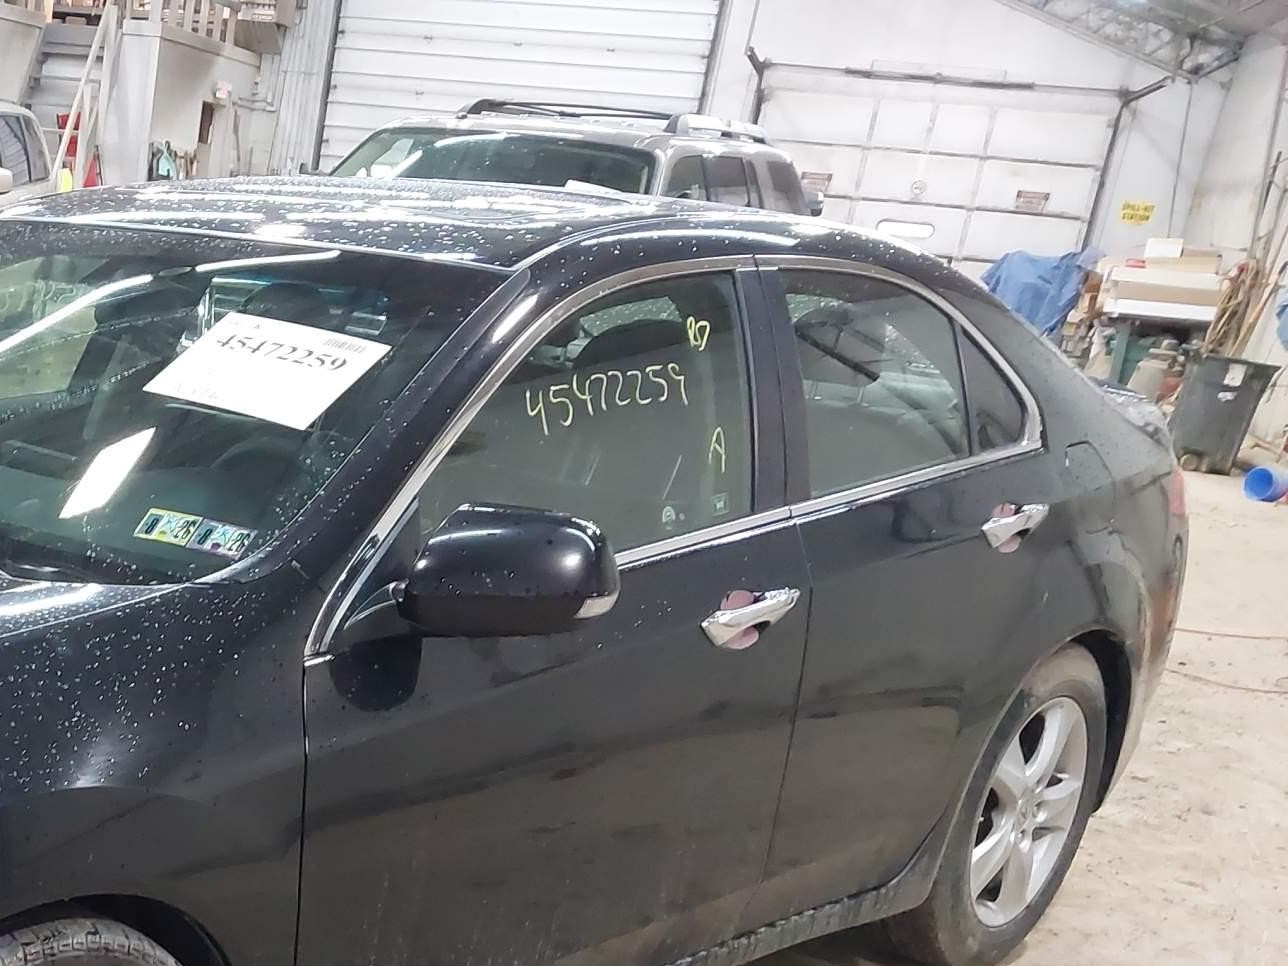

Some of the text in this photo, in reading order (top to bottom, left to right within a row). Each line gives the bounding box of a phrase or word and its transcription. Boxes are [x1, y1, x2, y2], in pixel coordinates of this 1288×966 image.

[216, 334, 348, 371] 45472259
[525, 363, 689, 436] 45472259
[708, 426, 726, 474] A
[173, 519, 197, 540] 26
[228, 531, 252, 553] 26
